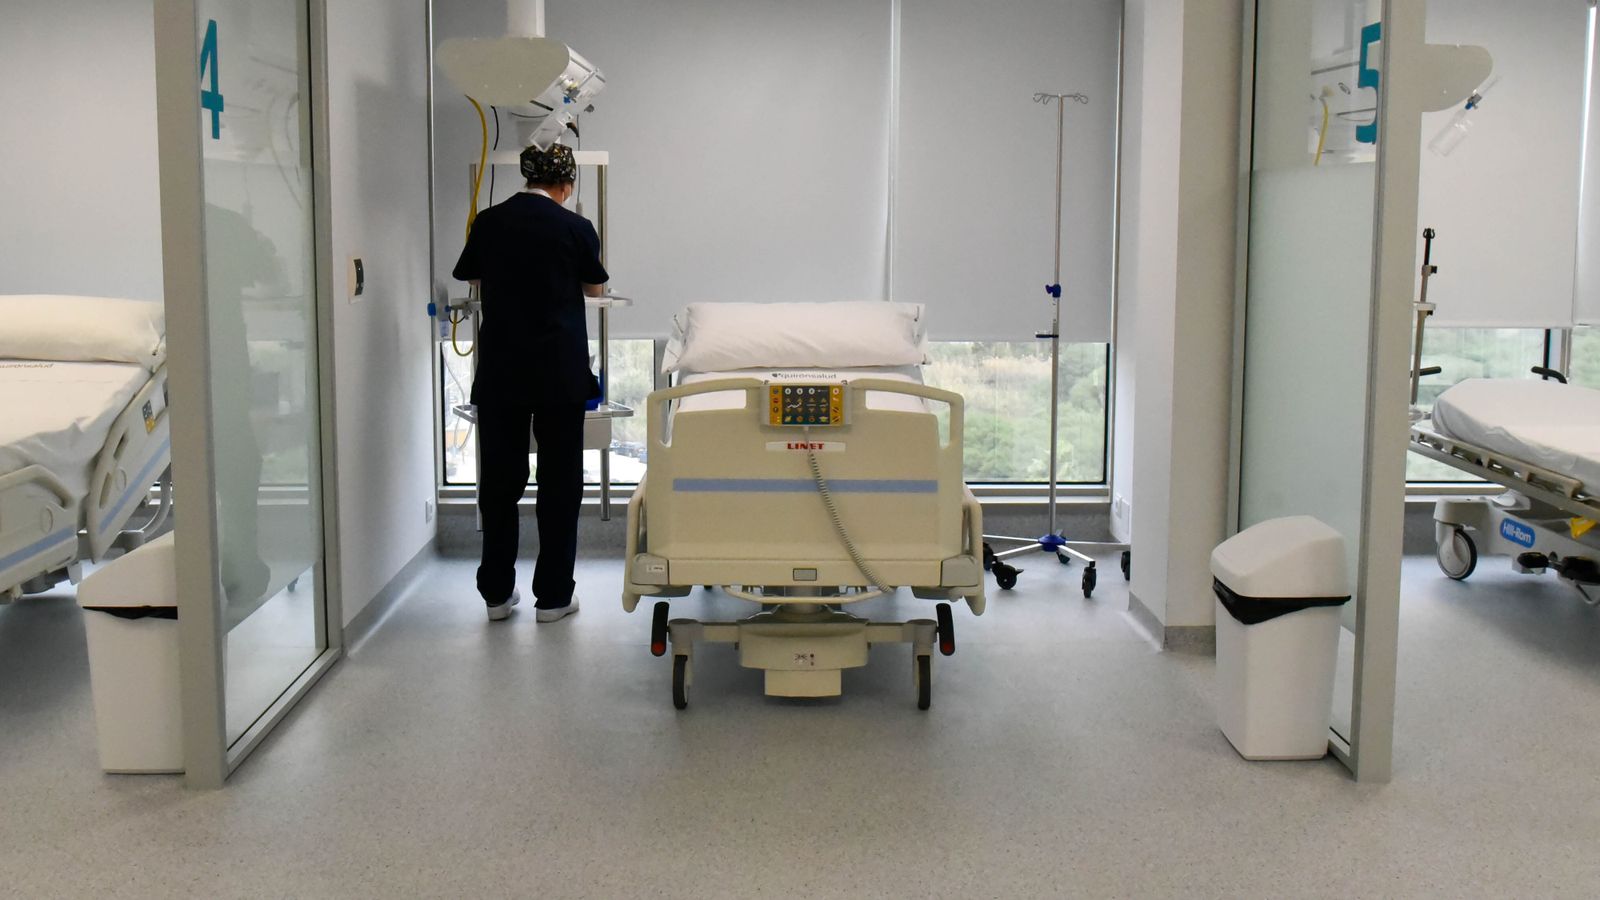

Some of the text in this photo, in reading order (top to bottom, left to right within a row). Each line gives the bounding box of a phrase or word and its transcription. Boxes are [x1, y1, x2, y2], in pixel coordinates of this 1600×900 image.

[200, 19, 224, 140] 4
[1355, 21, 1381, 144] 5
[787, 442, 825, 450] LINET
[1503, 521, 1532, 544] Hill-Rom
